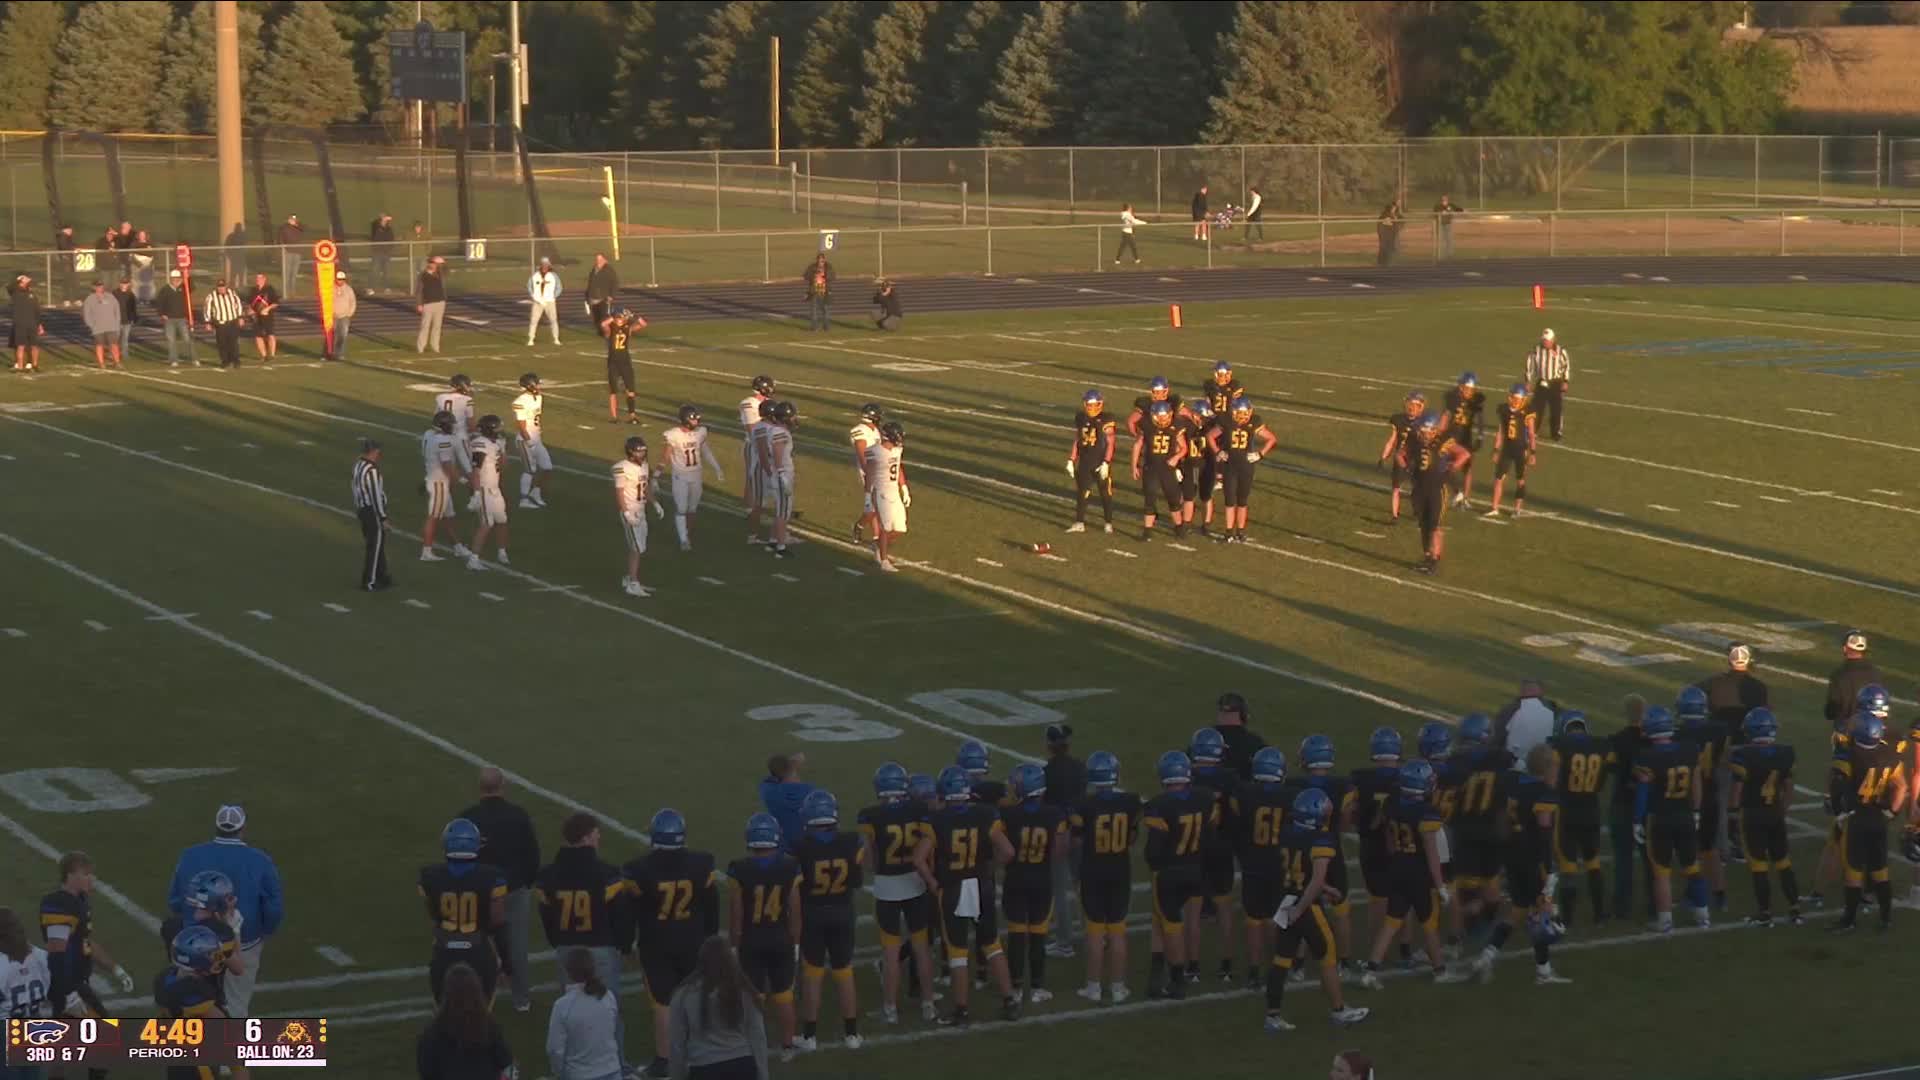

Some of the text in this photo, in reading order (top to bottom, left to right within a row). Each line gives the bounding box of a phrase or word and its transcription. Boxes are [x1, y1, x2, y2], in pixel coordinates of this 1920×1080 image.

[76, 253, 95, 271] 20
[470, 243, 485, 260] 10
[615, 333, 626, 350] 12
[1081, 427, 1098, 447] 54
[1153, 434, 1171, 455] 55
[1231, 430, 1249, 450] 53
[684, 449, 698, 468] 11
[1567, 752, 1602, 793] 88
[1664, 764, 1690, 800] 13
[1760, 768, 1777, 804] 4
[950, 827, 979, 870] 51
[1095, 812, 1129, 854] 60
[1175, 811, 1203, 856] 71
[810, 857, 849, 896] 52
[439, 891, 479, 934] 90
[556, 888, 593, 932] 79
[656, 879, 694, 921] 72
[752, 883, 783, 925] 14
